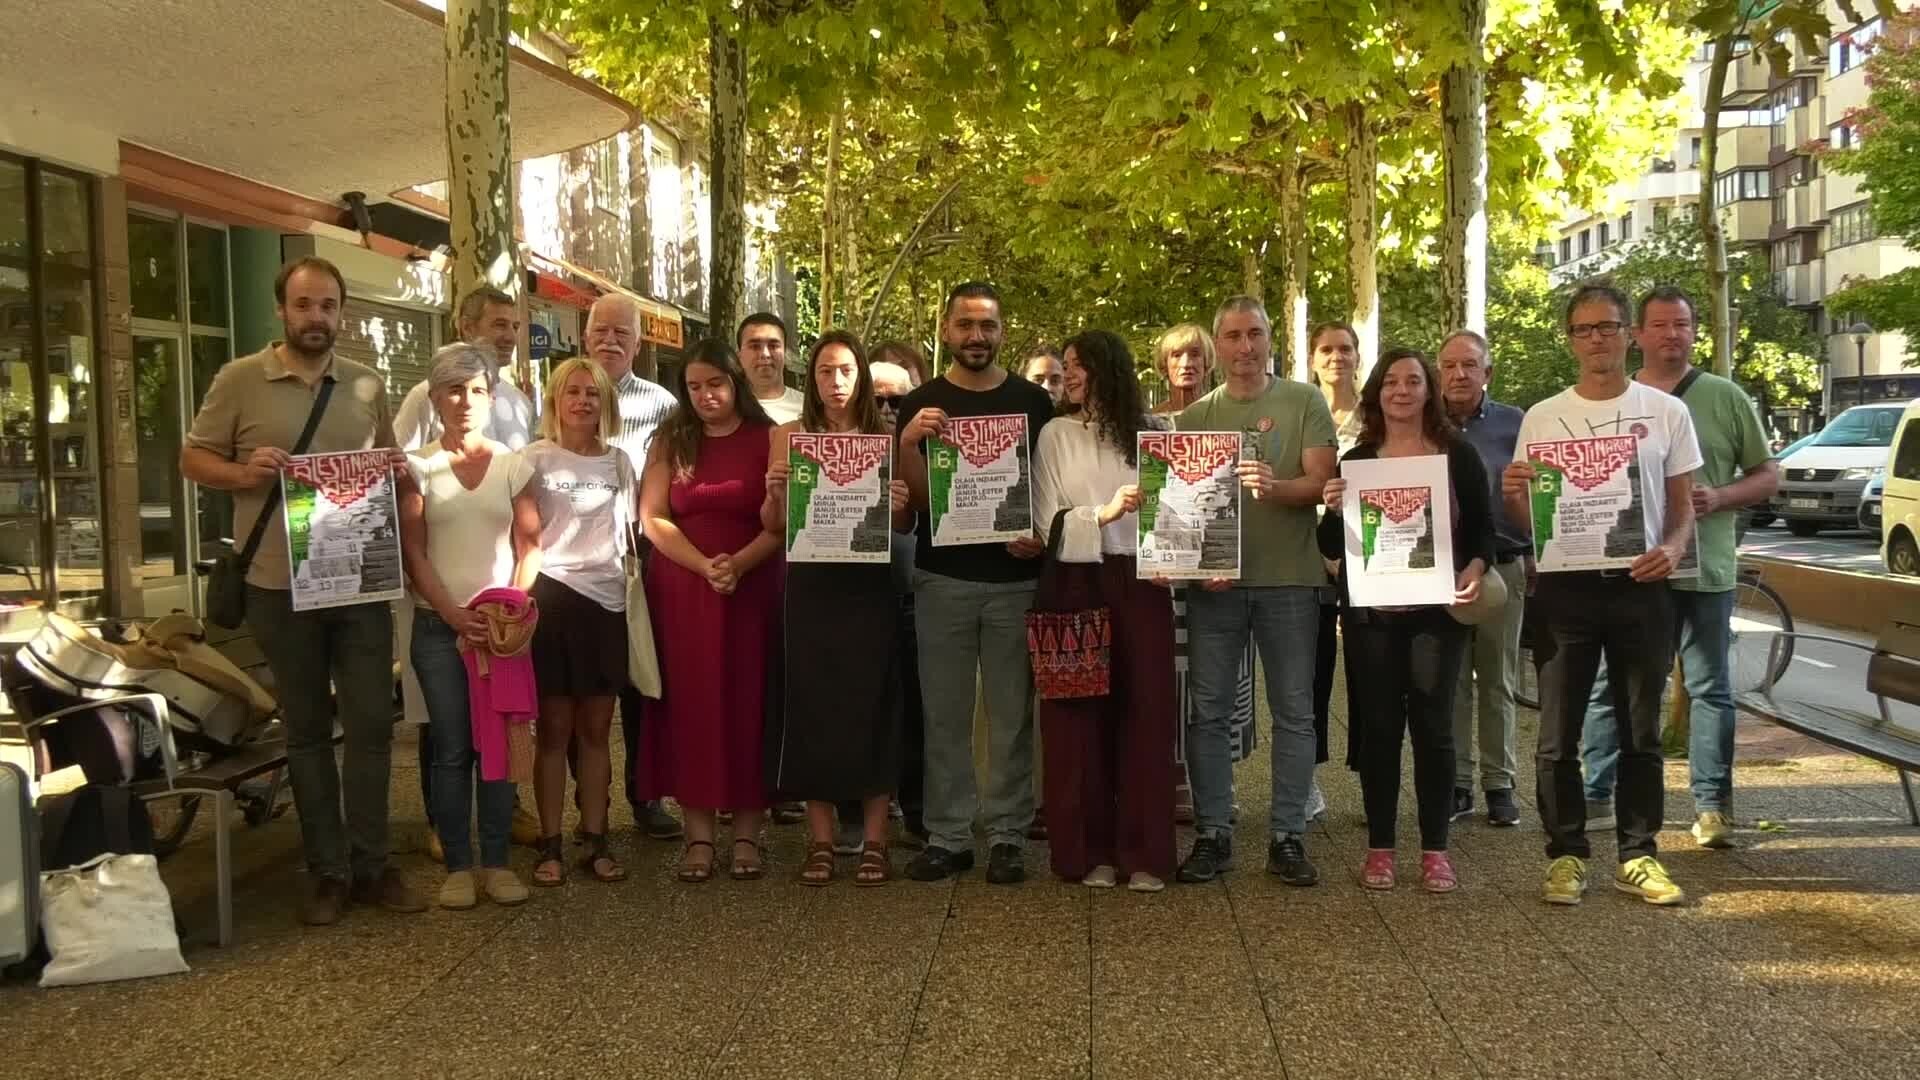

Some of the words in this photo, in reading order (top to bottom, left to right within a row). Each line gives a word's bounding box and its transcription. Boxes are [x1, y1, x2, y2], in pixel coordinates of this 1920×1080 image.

[150, 257, 157, 278] 6
[531, 335, 548, 346] IGI
[1141, 550, 1152, 558] 12
[1162, 552, 1174, 561] 13
